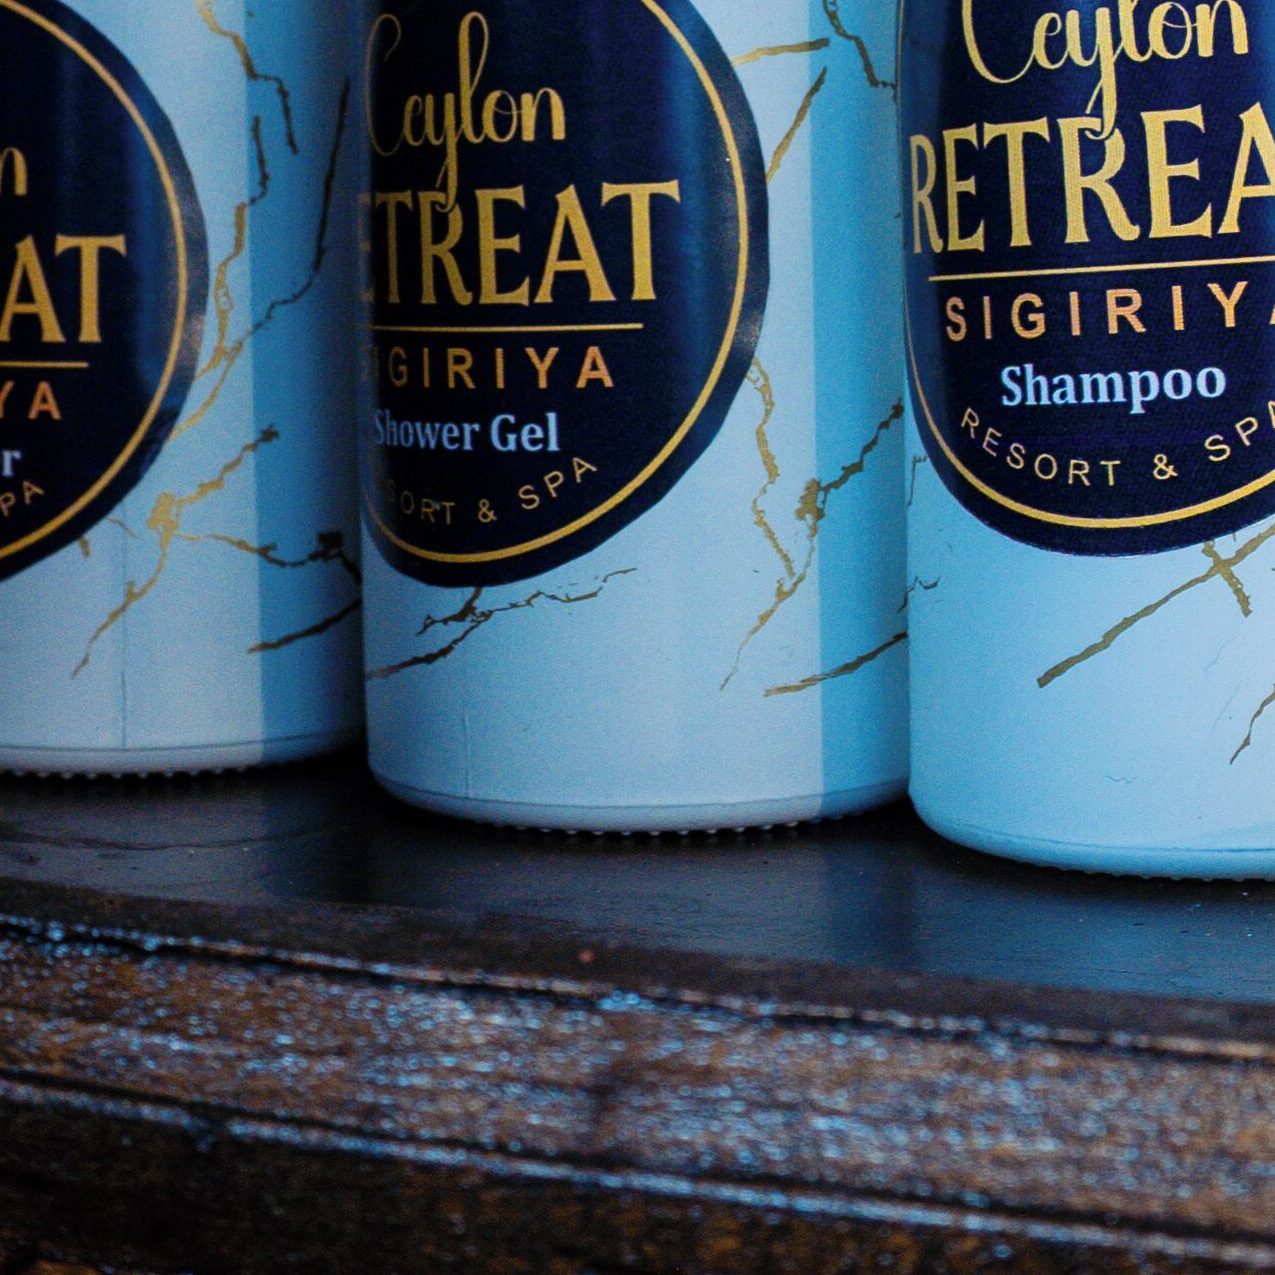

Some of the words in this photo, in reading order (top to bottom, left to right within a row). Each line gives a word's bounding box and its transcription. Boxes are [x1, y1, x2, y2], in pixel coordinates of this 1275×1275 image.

[364, 10, 567, 212] Ceylon
[358, 178, 681, 308] ETREAT
[374, 344, 614, 390] IGIRIYA
[1000, 363, 1227, 415] Shampoo
[374, 407, 480, 451] Shower
[489, 411, 561, 452] Gel
[960, 407, 1122, 487] RESORT
[1152, 453, 1180, 481] &
[385, 477, 456, 525] SORT
[477, 498, 498, 523] &
[517, 456, 598, 510] SPA
